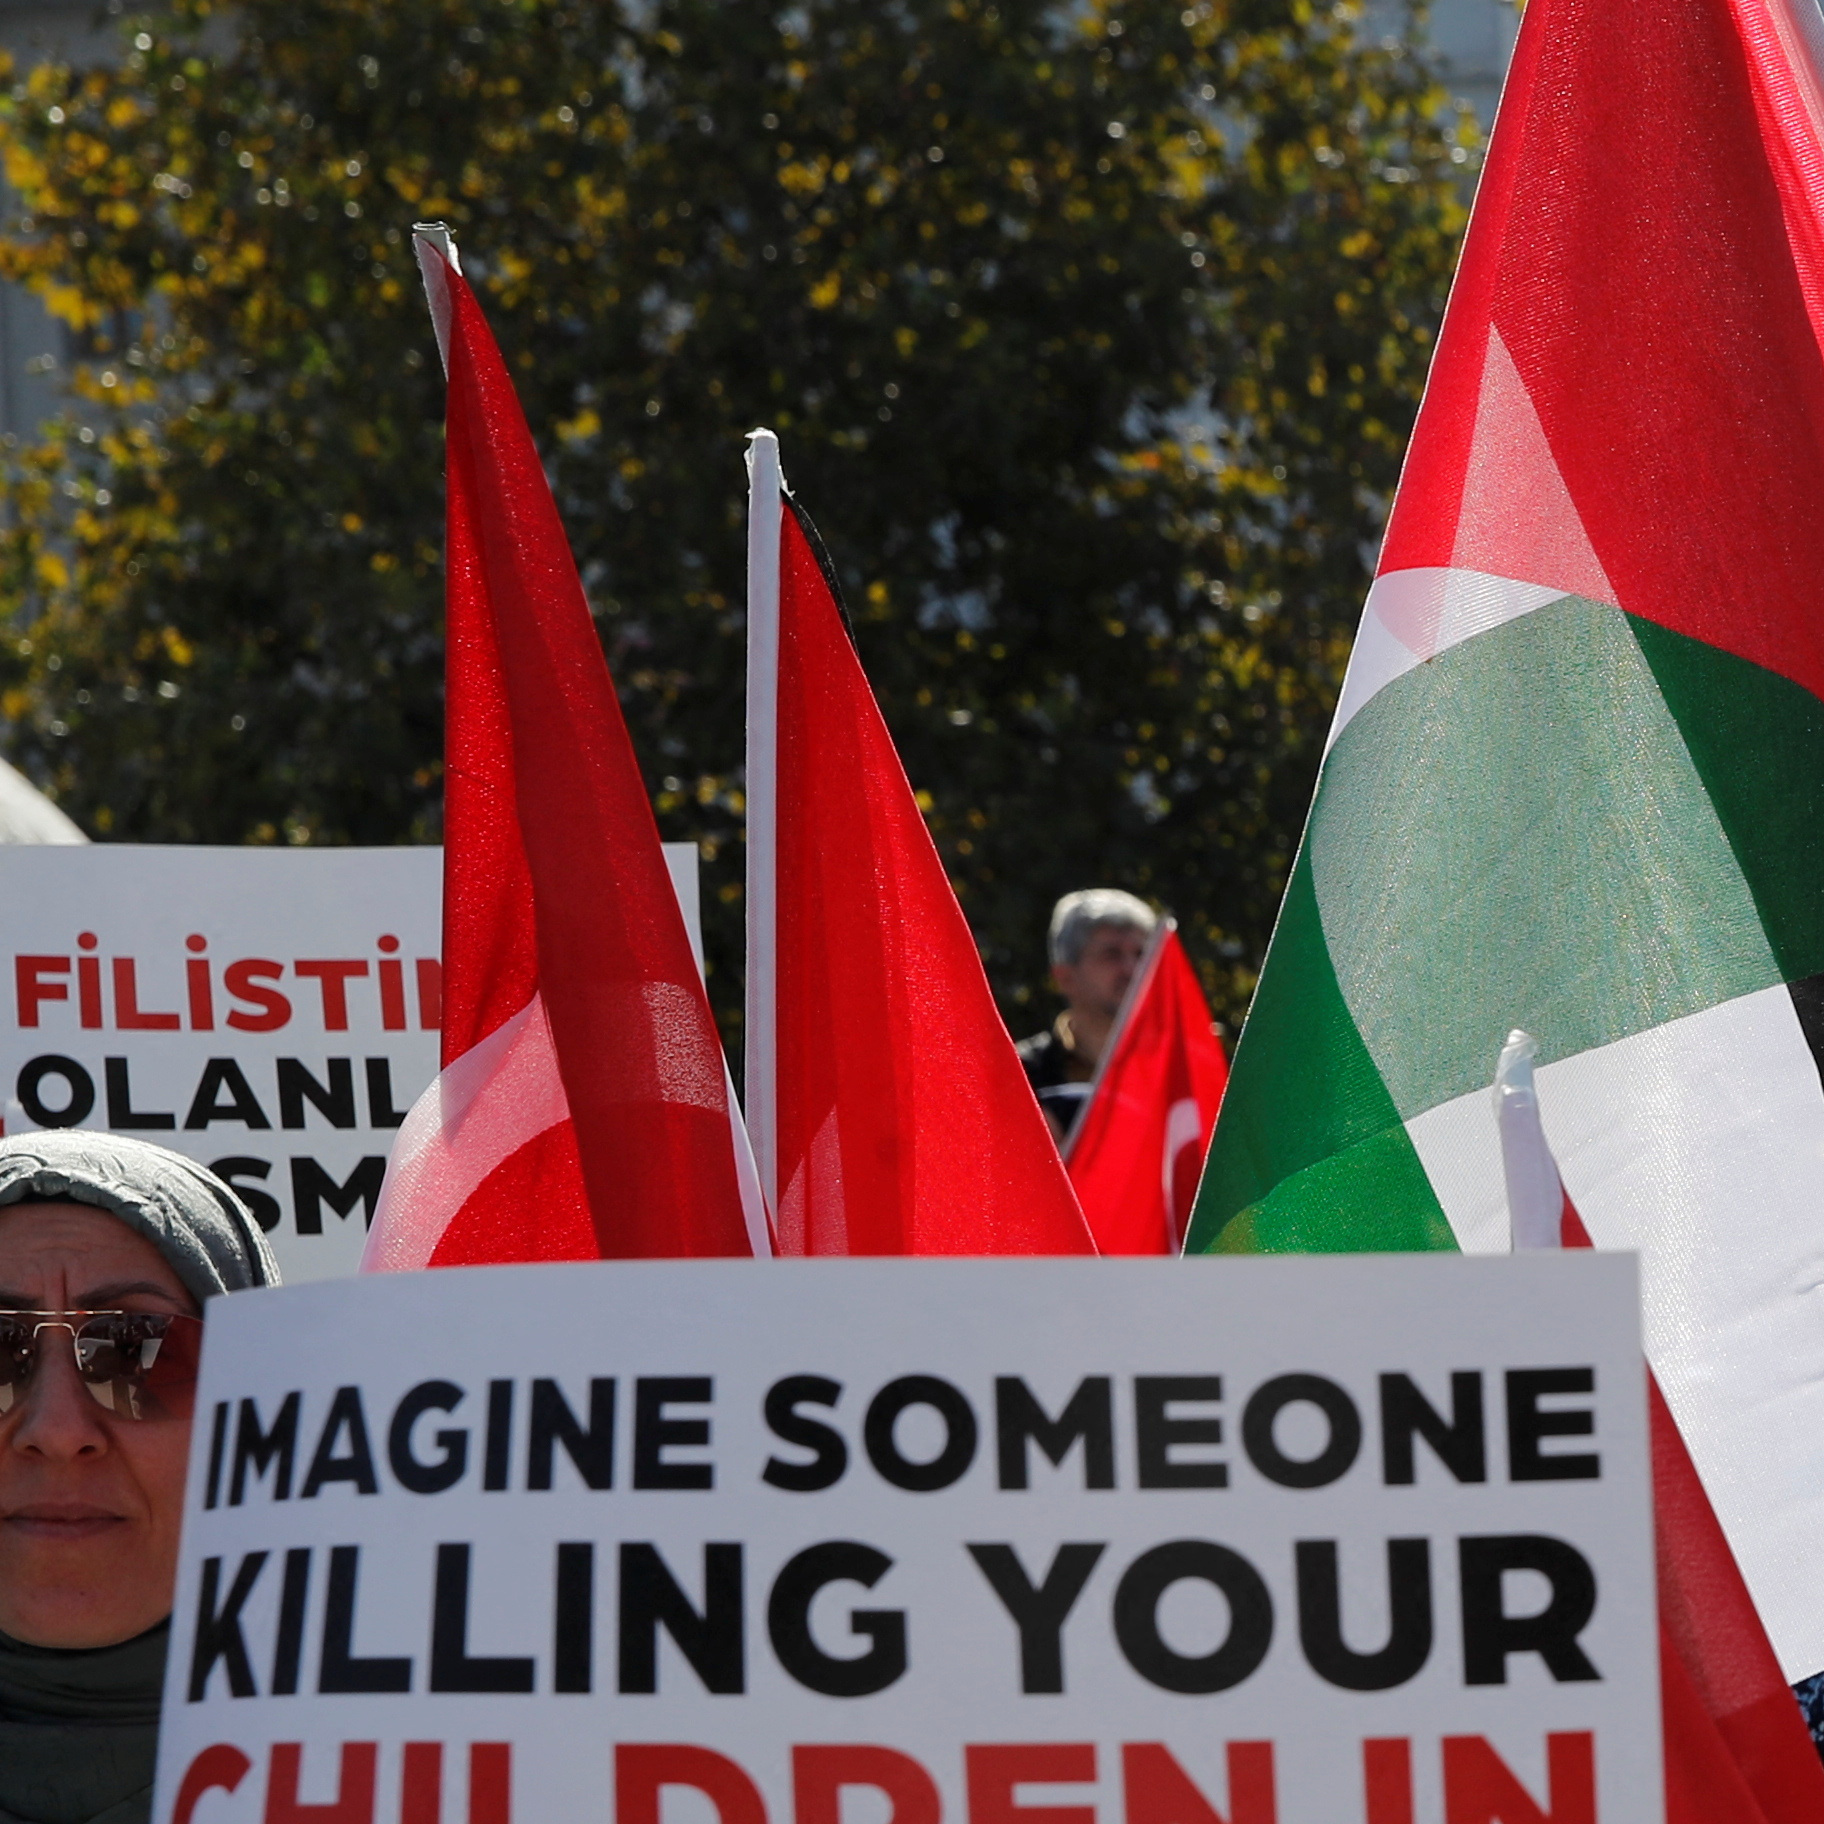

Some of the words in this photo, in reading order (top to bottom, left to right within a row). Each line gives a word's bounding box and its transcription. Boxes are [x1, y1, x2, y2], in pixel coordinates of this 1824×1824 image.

[204, 1378, 714, 1508] IMAGINE
[760, 1368, 1600, 1492] SOMEONE
[187, 1541, 908, 1703] KILLING
[966, 1535, 1602, 1697] YOUR
